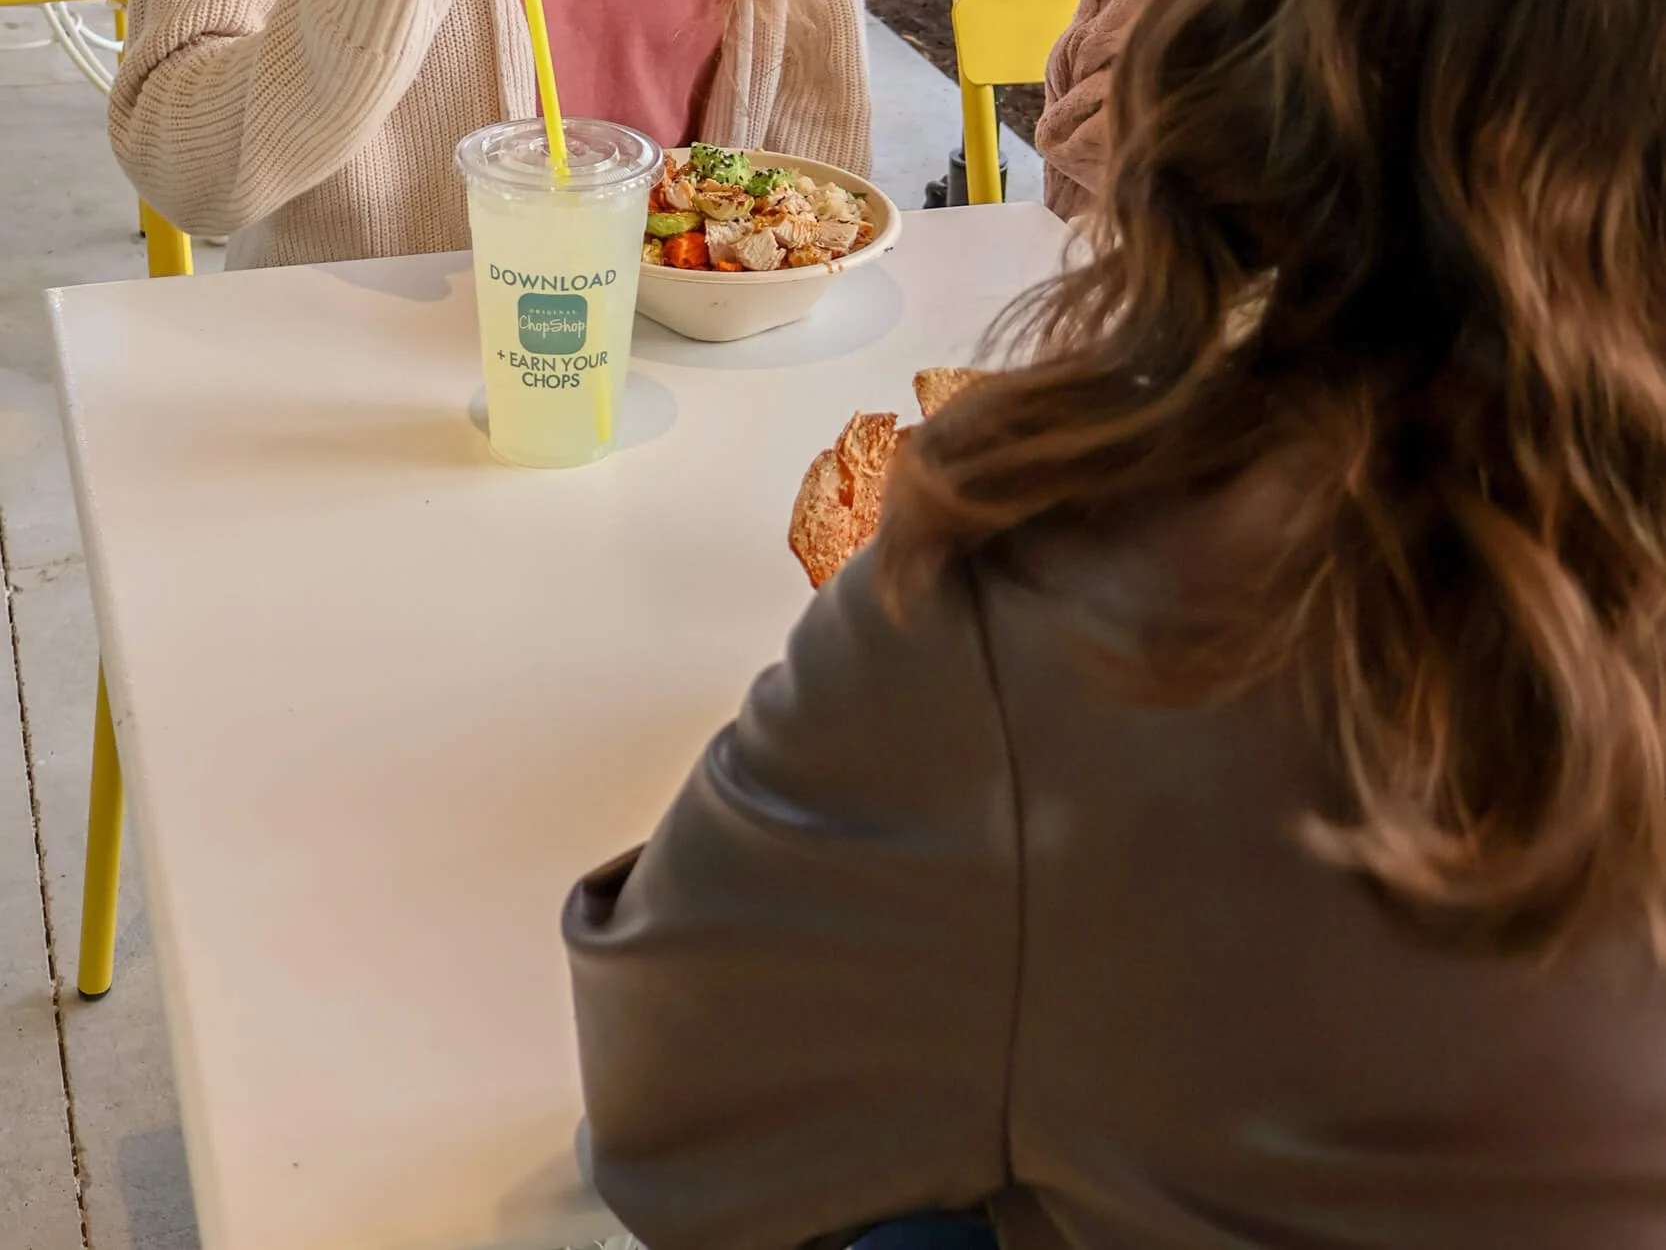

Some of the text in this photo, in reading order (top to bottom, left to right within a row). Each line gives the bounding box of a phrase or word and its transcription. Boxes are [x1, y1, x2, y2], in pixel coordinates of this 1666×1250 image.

[490, 263, 617, 291] DOWNLOAD
[510, 352, 556, 372] EARN
[562, 351, 608, 372] YOUR
[522, 372, 580, 389] CHOPS
